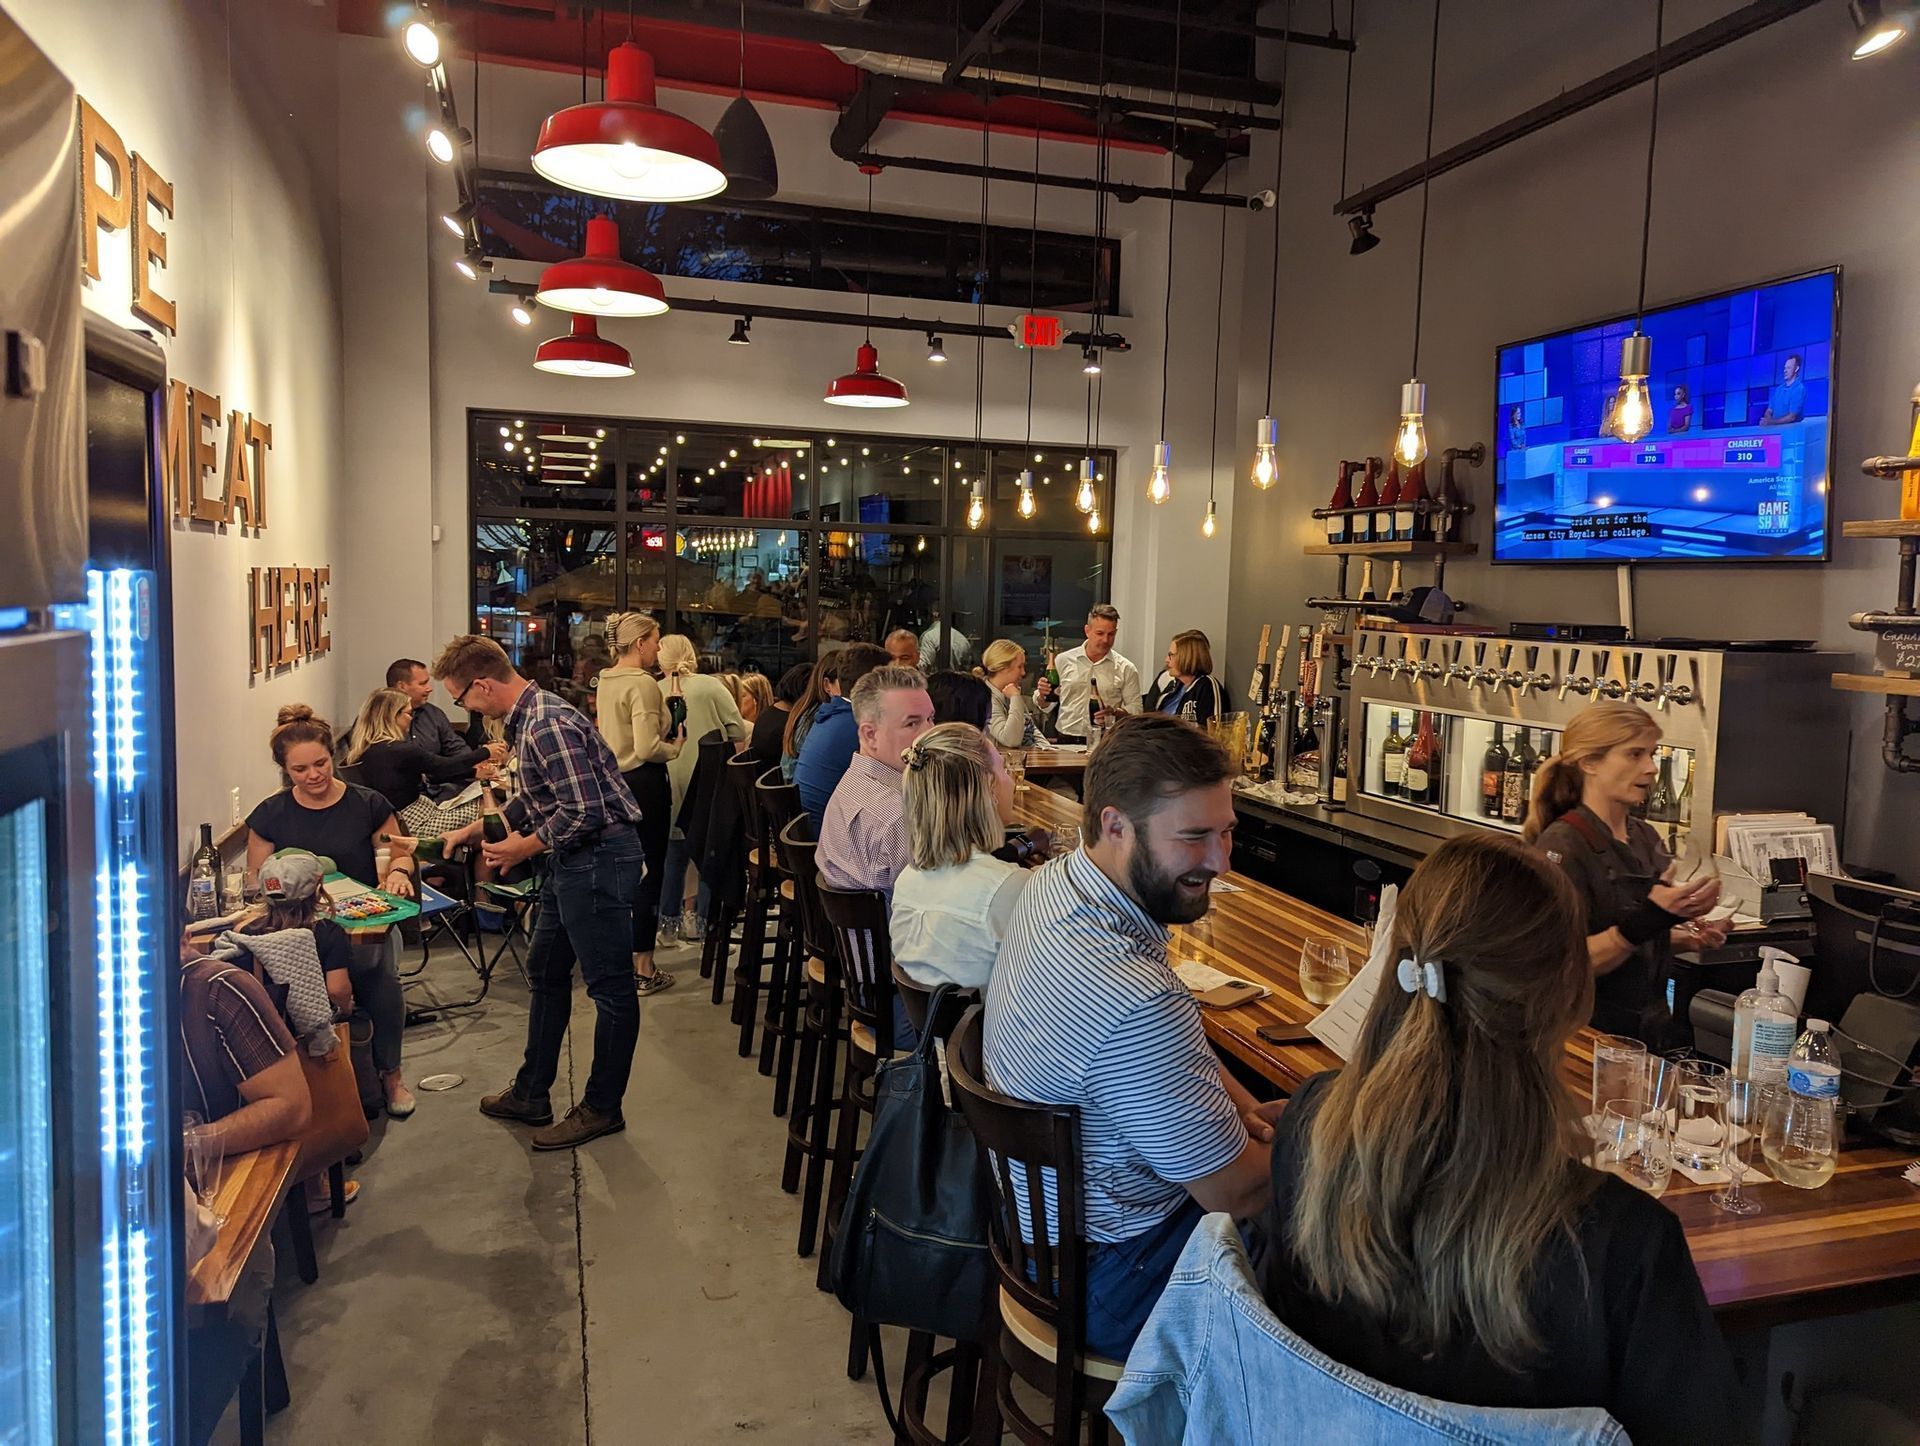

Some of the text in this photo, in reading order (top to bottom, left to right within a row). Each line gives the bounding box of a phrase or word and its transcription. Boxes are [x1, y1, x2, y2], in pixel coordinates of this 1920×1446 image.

[1728, 439, 1763, 449] CHARLEY
[1737, 453, 1752, 461] 310
[1758, 502, 1789, 516] GAME
[1614, 515, 1628, 525] for
[1633, 514, 1648, 524] the
[1549, 530, 1566, 541] City
[1569, 529, 1595, 541] Royals
[1599, 529, 1608, 537] in
[1613, 528, 1651, 539] college.
[251, 565, 331, 675] HERE
